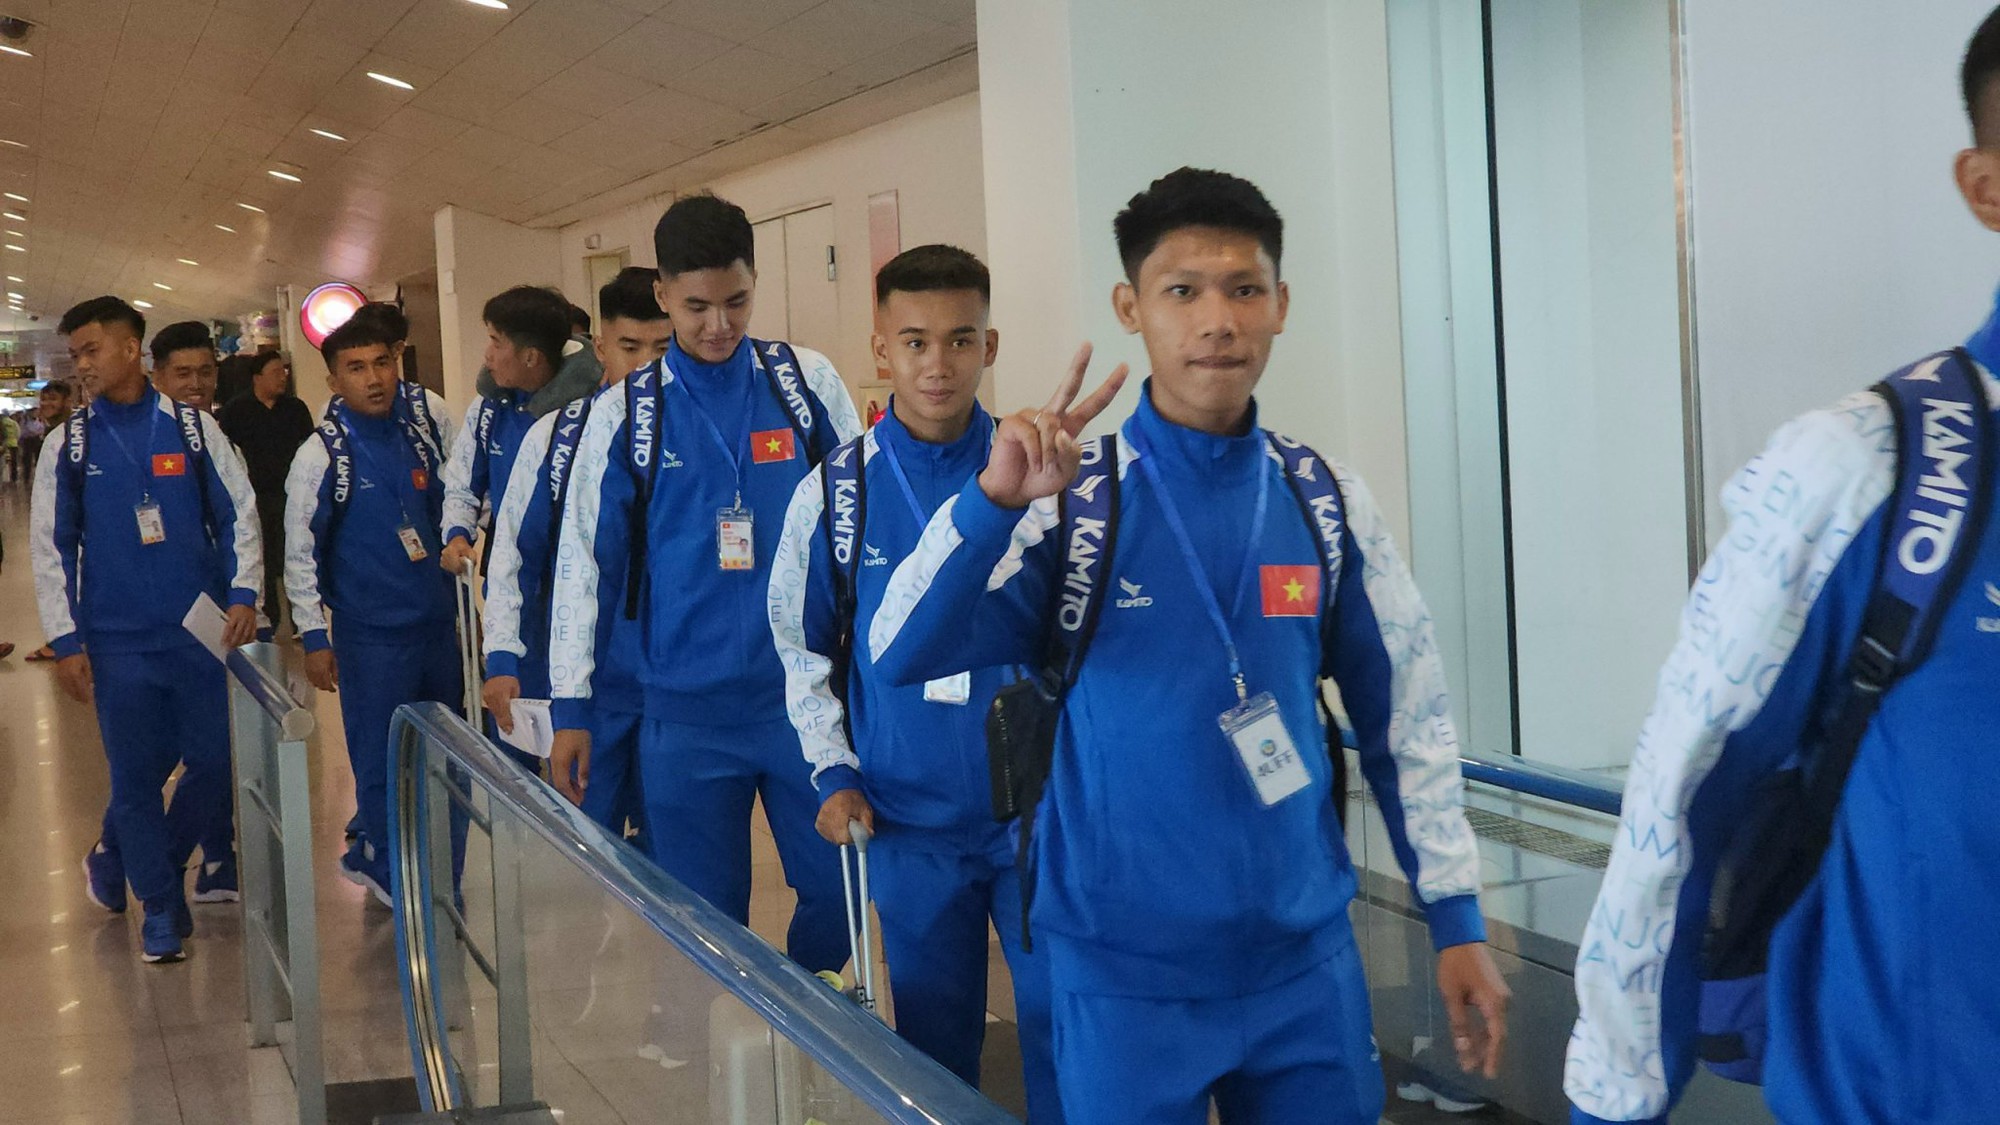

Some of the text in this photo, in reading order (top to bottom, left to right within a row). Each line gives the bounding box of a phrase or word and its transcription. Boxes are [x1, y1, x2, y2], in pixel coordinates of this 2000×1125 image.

[180, 407, 202, 452] KAMITO
[774, 362, 812, 429] KAMITO
[70, 417, 84, 463] KAMITO
[634, 397, 655, 467] KAMITO
[334, 455, 350, 502] KAMITO
[1898, 398, 1974, 575] KAMITO
[834, 479, 857, 564] KAMITO
[1059, 516, 1107, 631] KAMITO
